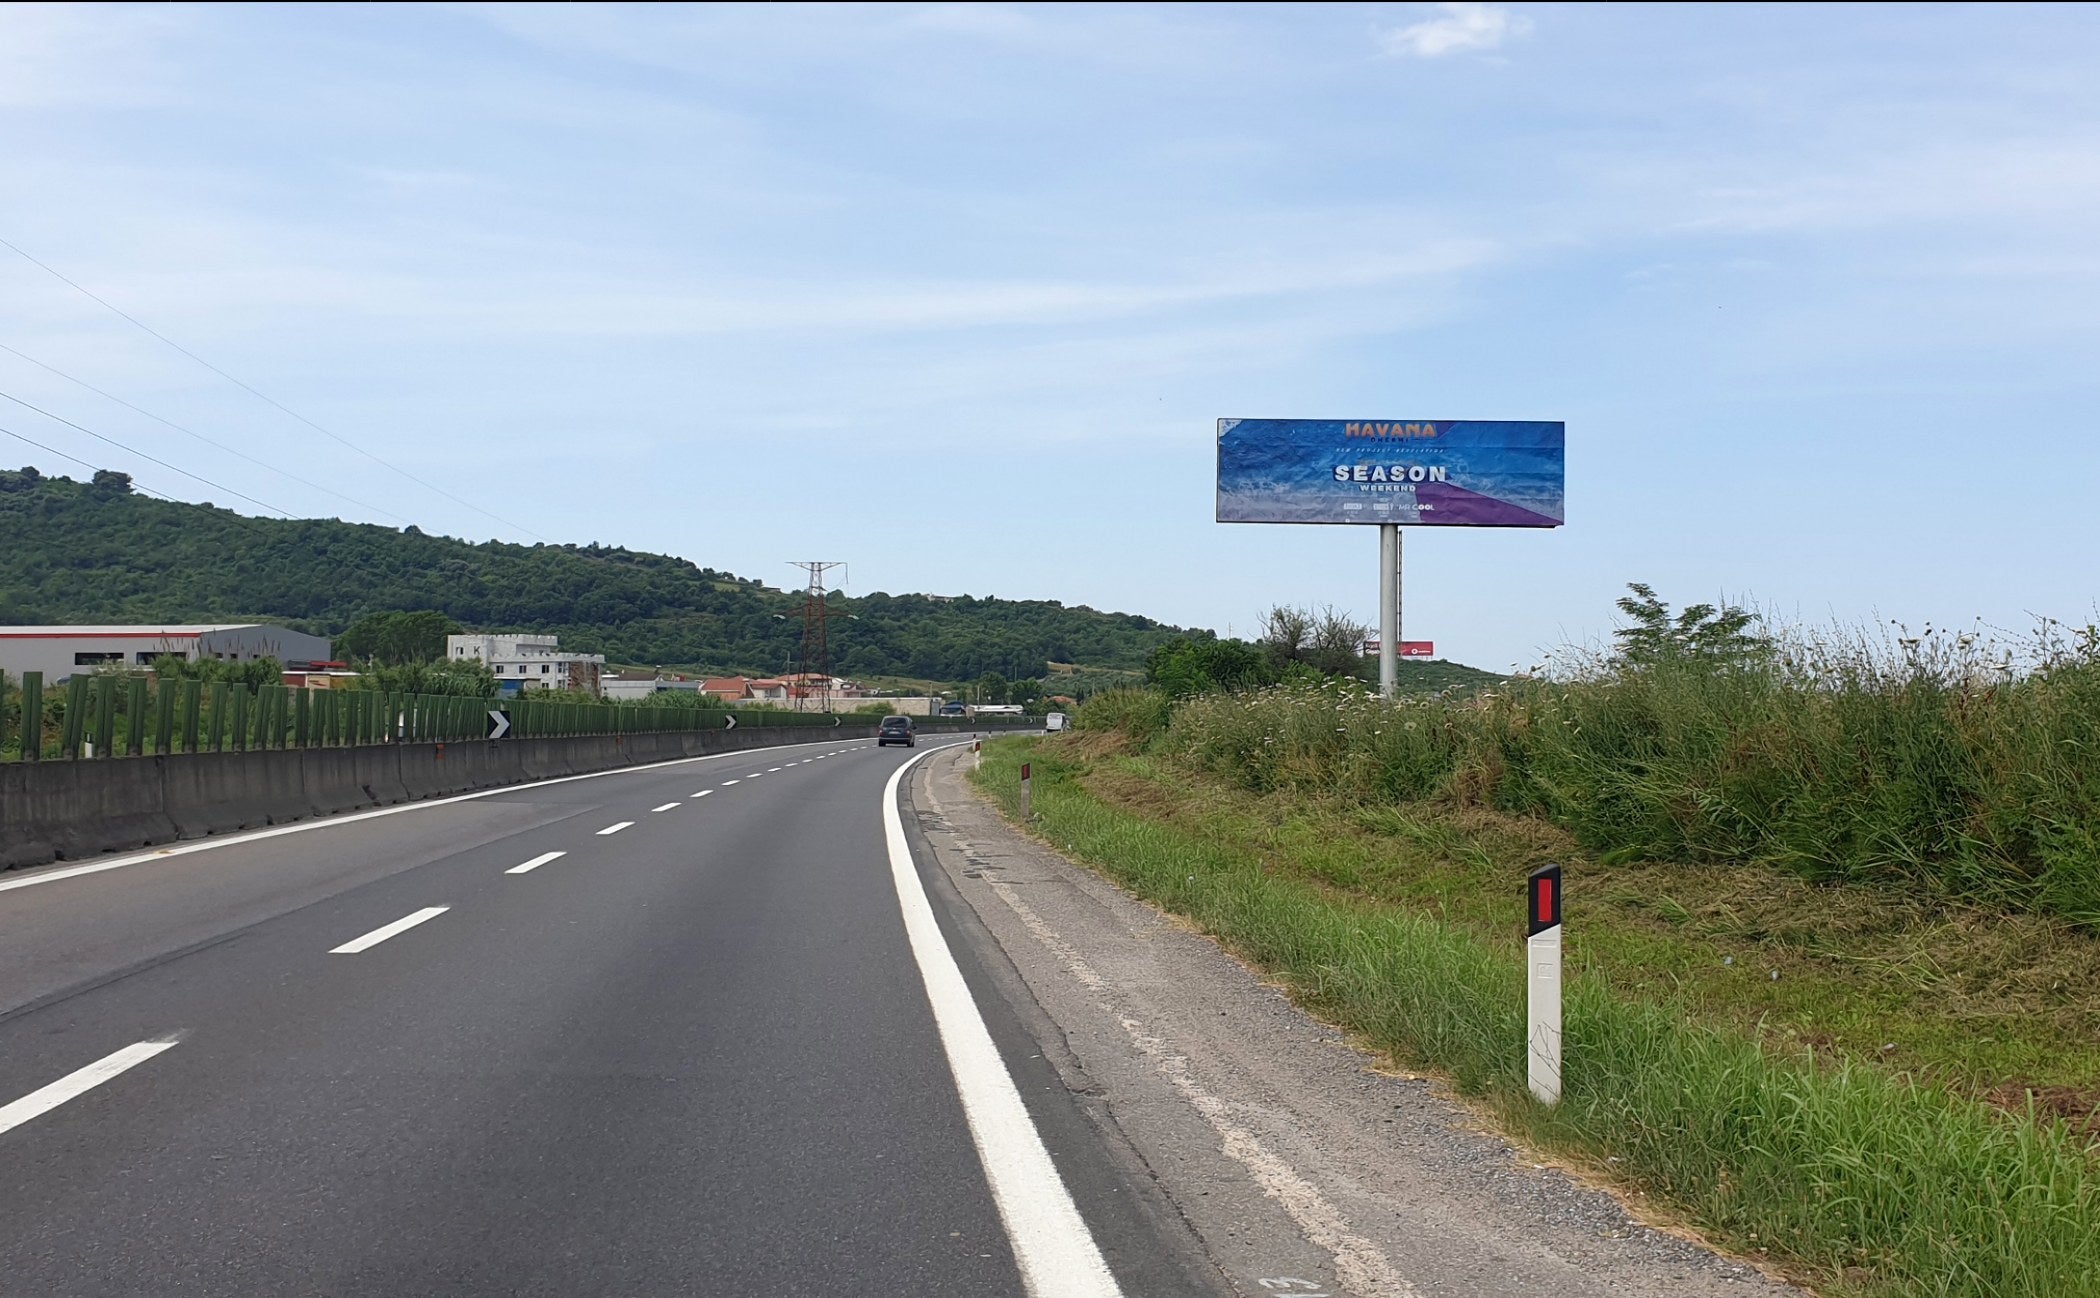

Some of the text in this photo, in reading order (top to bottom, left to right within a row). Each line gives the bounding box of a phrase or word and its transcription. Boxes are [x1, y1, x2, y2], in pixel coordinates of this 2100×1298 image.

[1345, 423, 1435, 437] HAVANA
[1335, 465, 1446, 482] SEASON
[1359, 484, 1417, 492] WEEKEND
[1411, 503, 1435, 511] COOL
